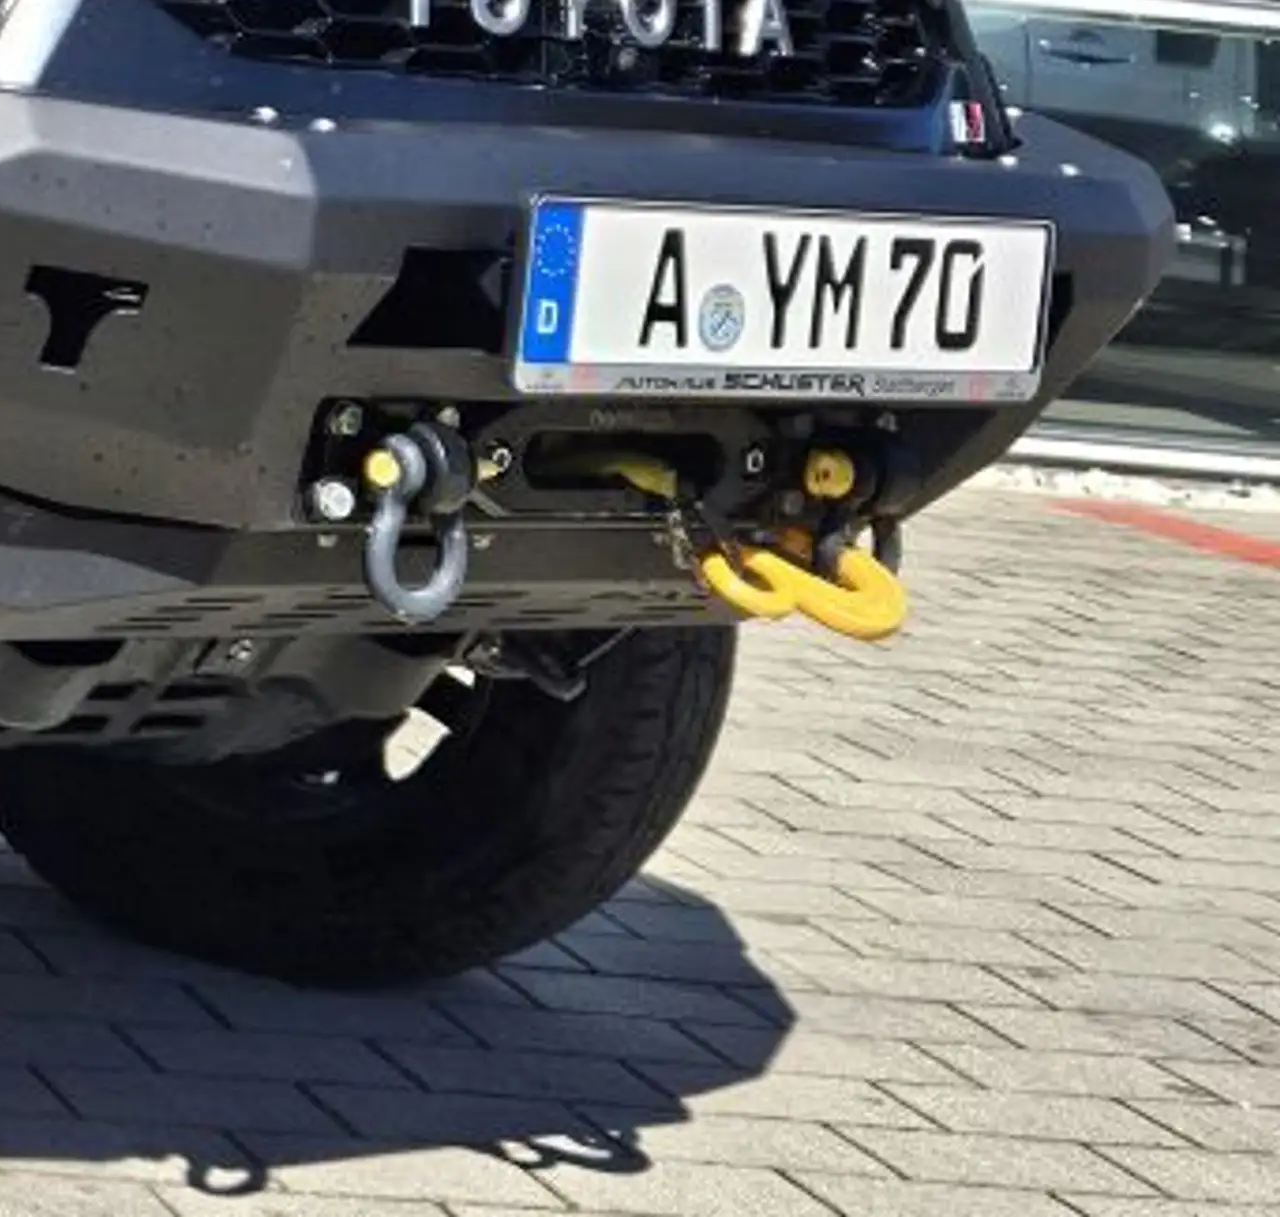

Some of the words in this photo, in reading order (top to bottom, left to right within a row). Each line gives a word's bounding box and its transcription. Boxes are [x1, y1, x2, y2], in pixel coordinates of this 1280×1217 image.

[638, 227, 688, 349] A
[762, 230, 869, 350] YM
[889, 237, 985, 352] 70
[536, 300, 558, 334] D
[723, 372, 868, 397] SCHUSTER
